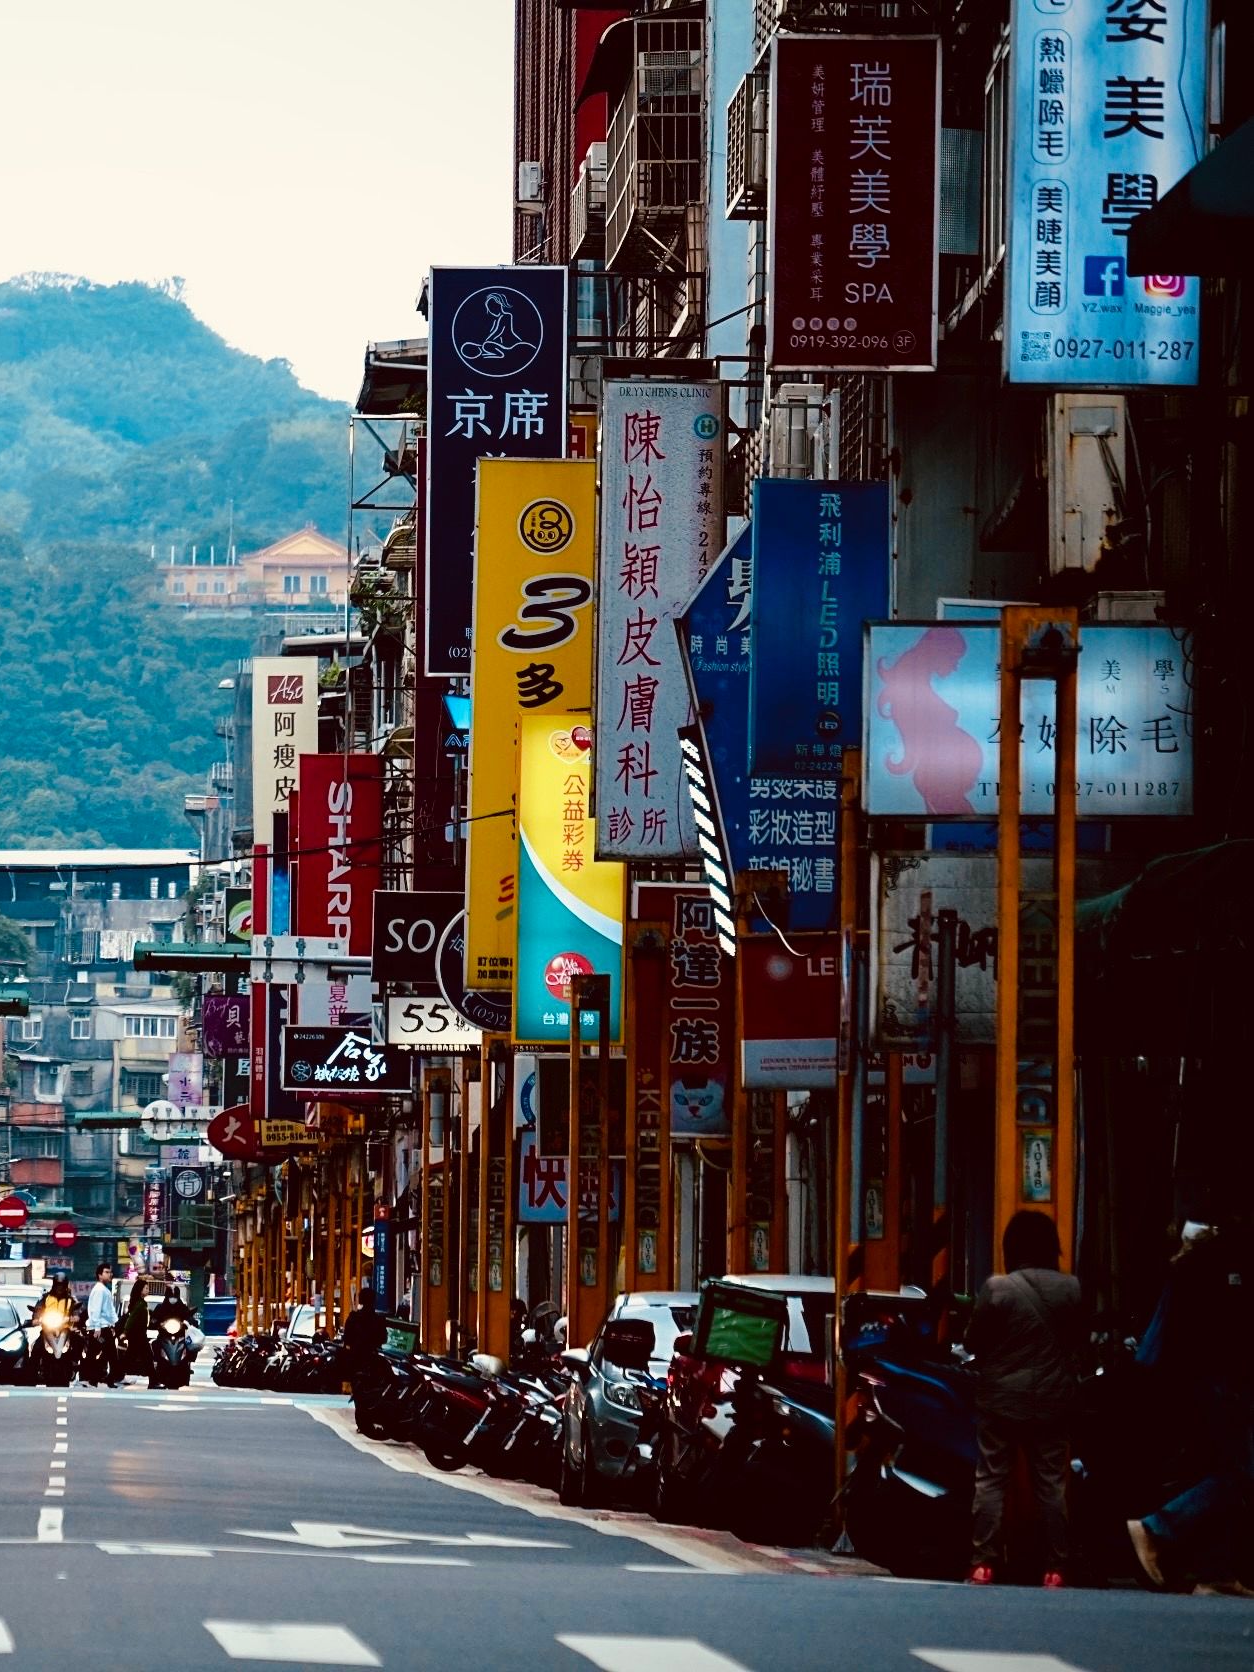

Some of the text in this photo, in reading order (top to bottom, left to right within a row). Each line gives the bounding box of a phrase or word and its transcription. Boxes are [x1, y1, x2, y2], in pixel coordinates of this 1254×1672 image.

[1038, 36, 1065, 158] 熱蠟除毛
[848, 61, 892, 268] 瑞芙美學
[1034, 186, 1063, 309] 美睫美顏
[845, 282, 894, 304] SPA
[1081, 302, 1123, 314] YZ.wax
[790, 334, 912, 349] 0919-392-096 3F
[1054, 338, 1196, 361] 0927-011-287
[680, 387, 712, 398] CLINIC
[444, 387, 549, 441] 京席
[817, 492, 842, 707] 飛利浦LED照明
[274, 711, 297, 812] 阿瘦皮
[1046, 782, 1181, 797] 027-011287
[561, 774, 585, 872] 公益彩券
[607, 805, 667, 847] 診所
[748, 809, 837, 846] 彩妝造型
[327, 780, 353, 940] SHARP
[477, 957, 513, 967] 訂位專
[477, 969, 513, 979] 加盟專
[670, 893, 722, 1065] 阿達一族
